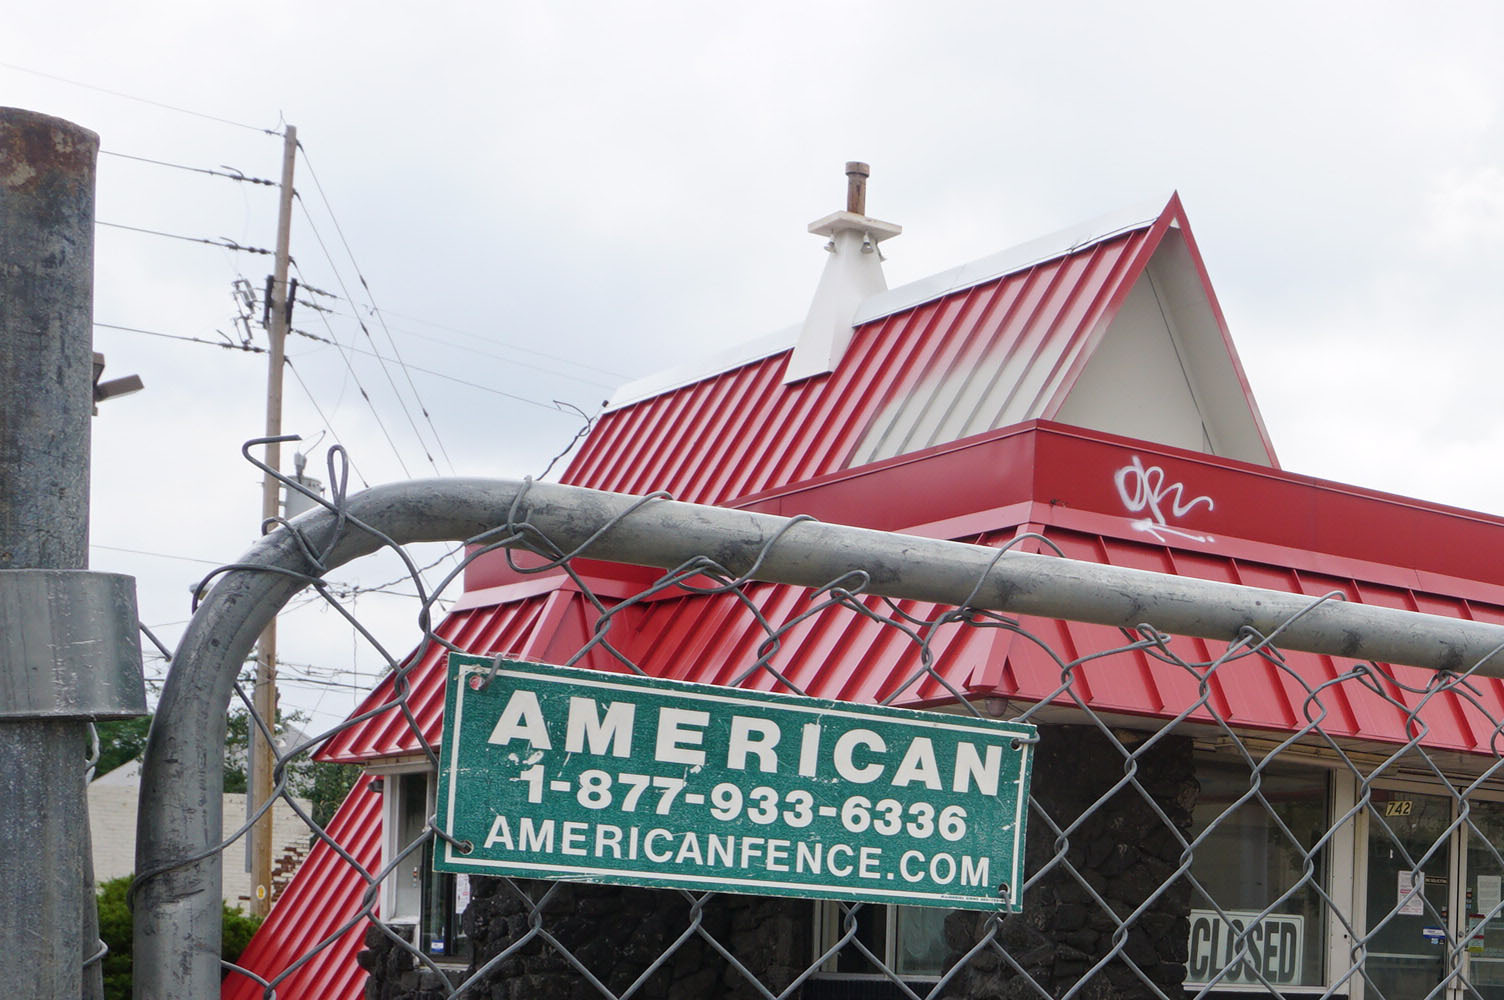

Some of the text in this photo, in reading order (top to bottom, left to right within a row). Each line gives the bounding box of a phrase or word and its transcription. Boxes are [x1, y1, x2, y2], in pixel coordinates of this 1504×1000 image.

[487, 690, 1003, 797] AMERICAN
[517, 763, 968, 843] 1-877-933-6336
[484, 815, 991, 888] AMERICANFENCE.COM
[1190, 917, 1297, 983] CLOSED
